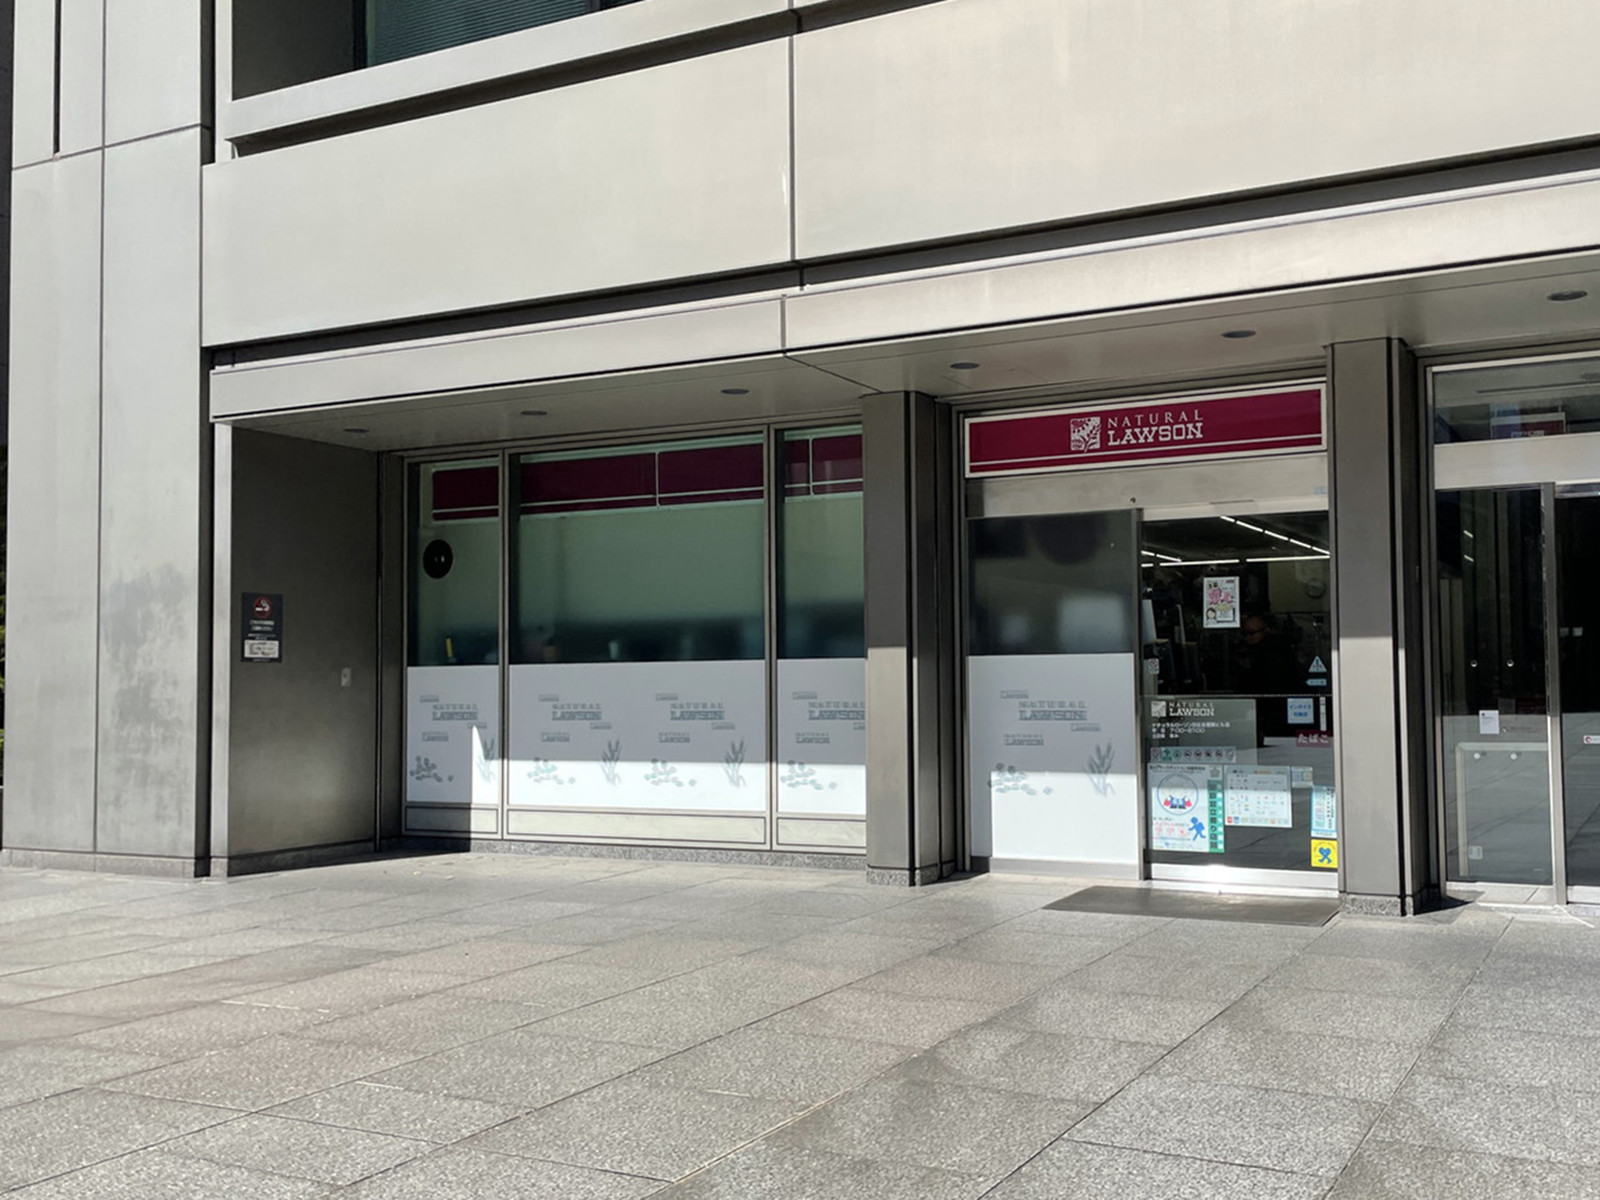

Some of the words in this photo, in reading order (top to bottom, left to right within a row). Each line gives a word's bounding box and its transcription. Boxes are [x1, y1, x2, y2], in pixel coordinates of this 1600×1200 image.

[1108, 409, 1204, 428] NATURAL
[1108, 422, 1204, 446] LAWSON
[432, 711, 479, 721] LAWSON
[551, 711, 602, 721] LAWSON
[670, 710, 725, 721] LAWSON
[808, 709, 865, 721] LAWSON
[1018, 709, 1087, 721] LAWSON
[1169, 708, 1215, 717] LAWSON
[1298, 733, 1329, 744] たばこ
